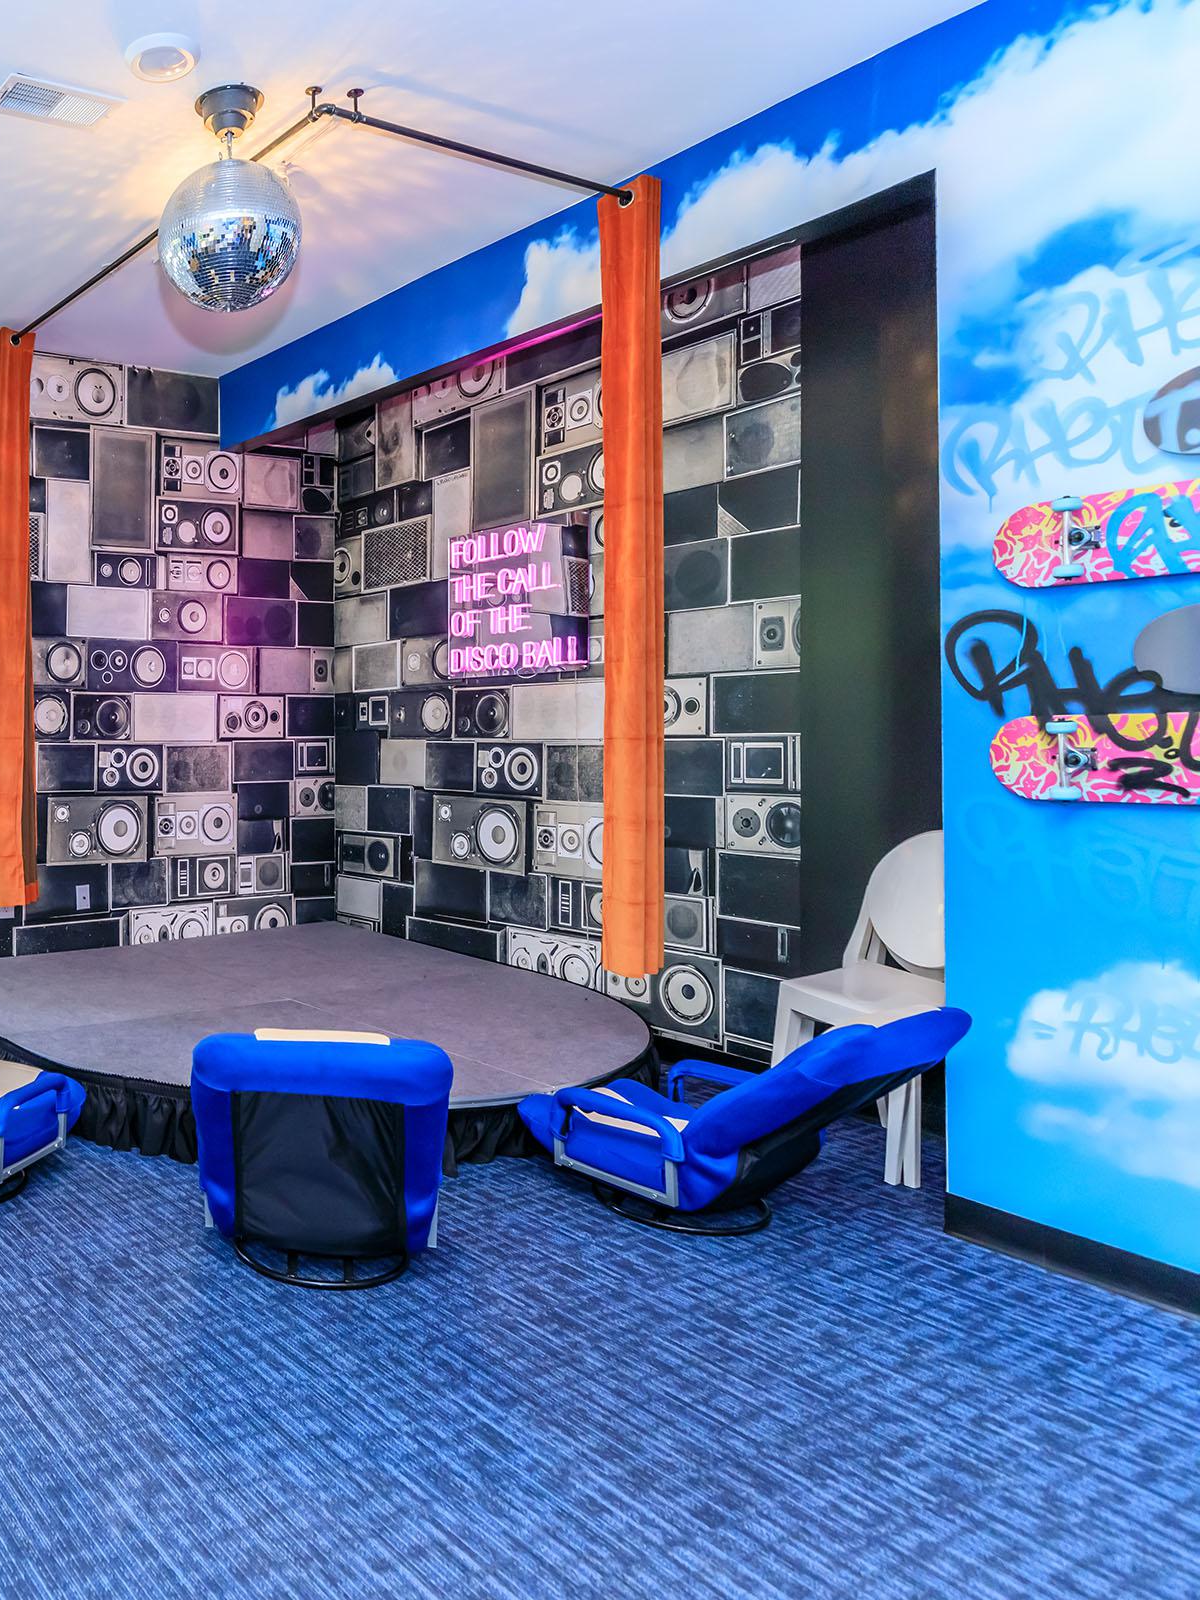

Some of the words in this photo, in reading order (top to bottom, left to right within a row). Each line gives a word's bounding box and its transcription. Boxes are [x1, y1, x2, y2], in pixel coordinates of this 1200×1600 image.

[450, 523, 547, 568] FOLLOW
[449, 571, 496, 604] THE
[497, 562, 561, 595] CALL
[450, 609, 482, 637] OF
[482, 603, 533, 634] THE
[450, 642, 518, 673] DISCO
[522, 636, 588, 668] BALL
